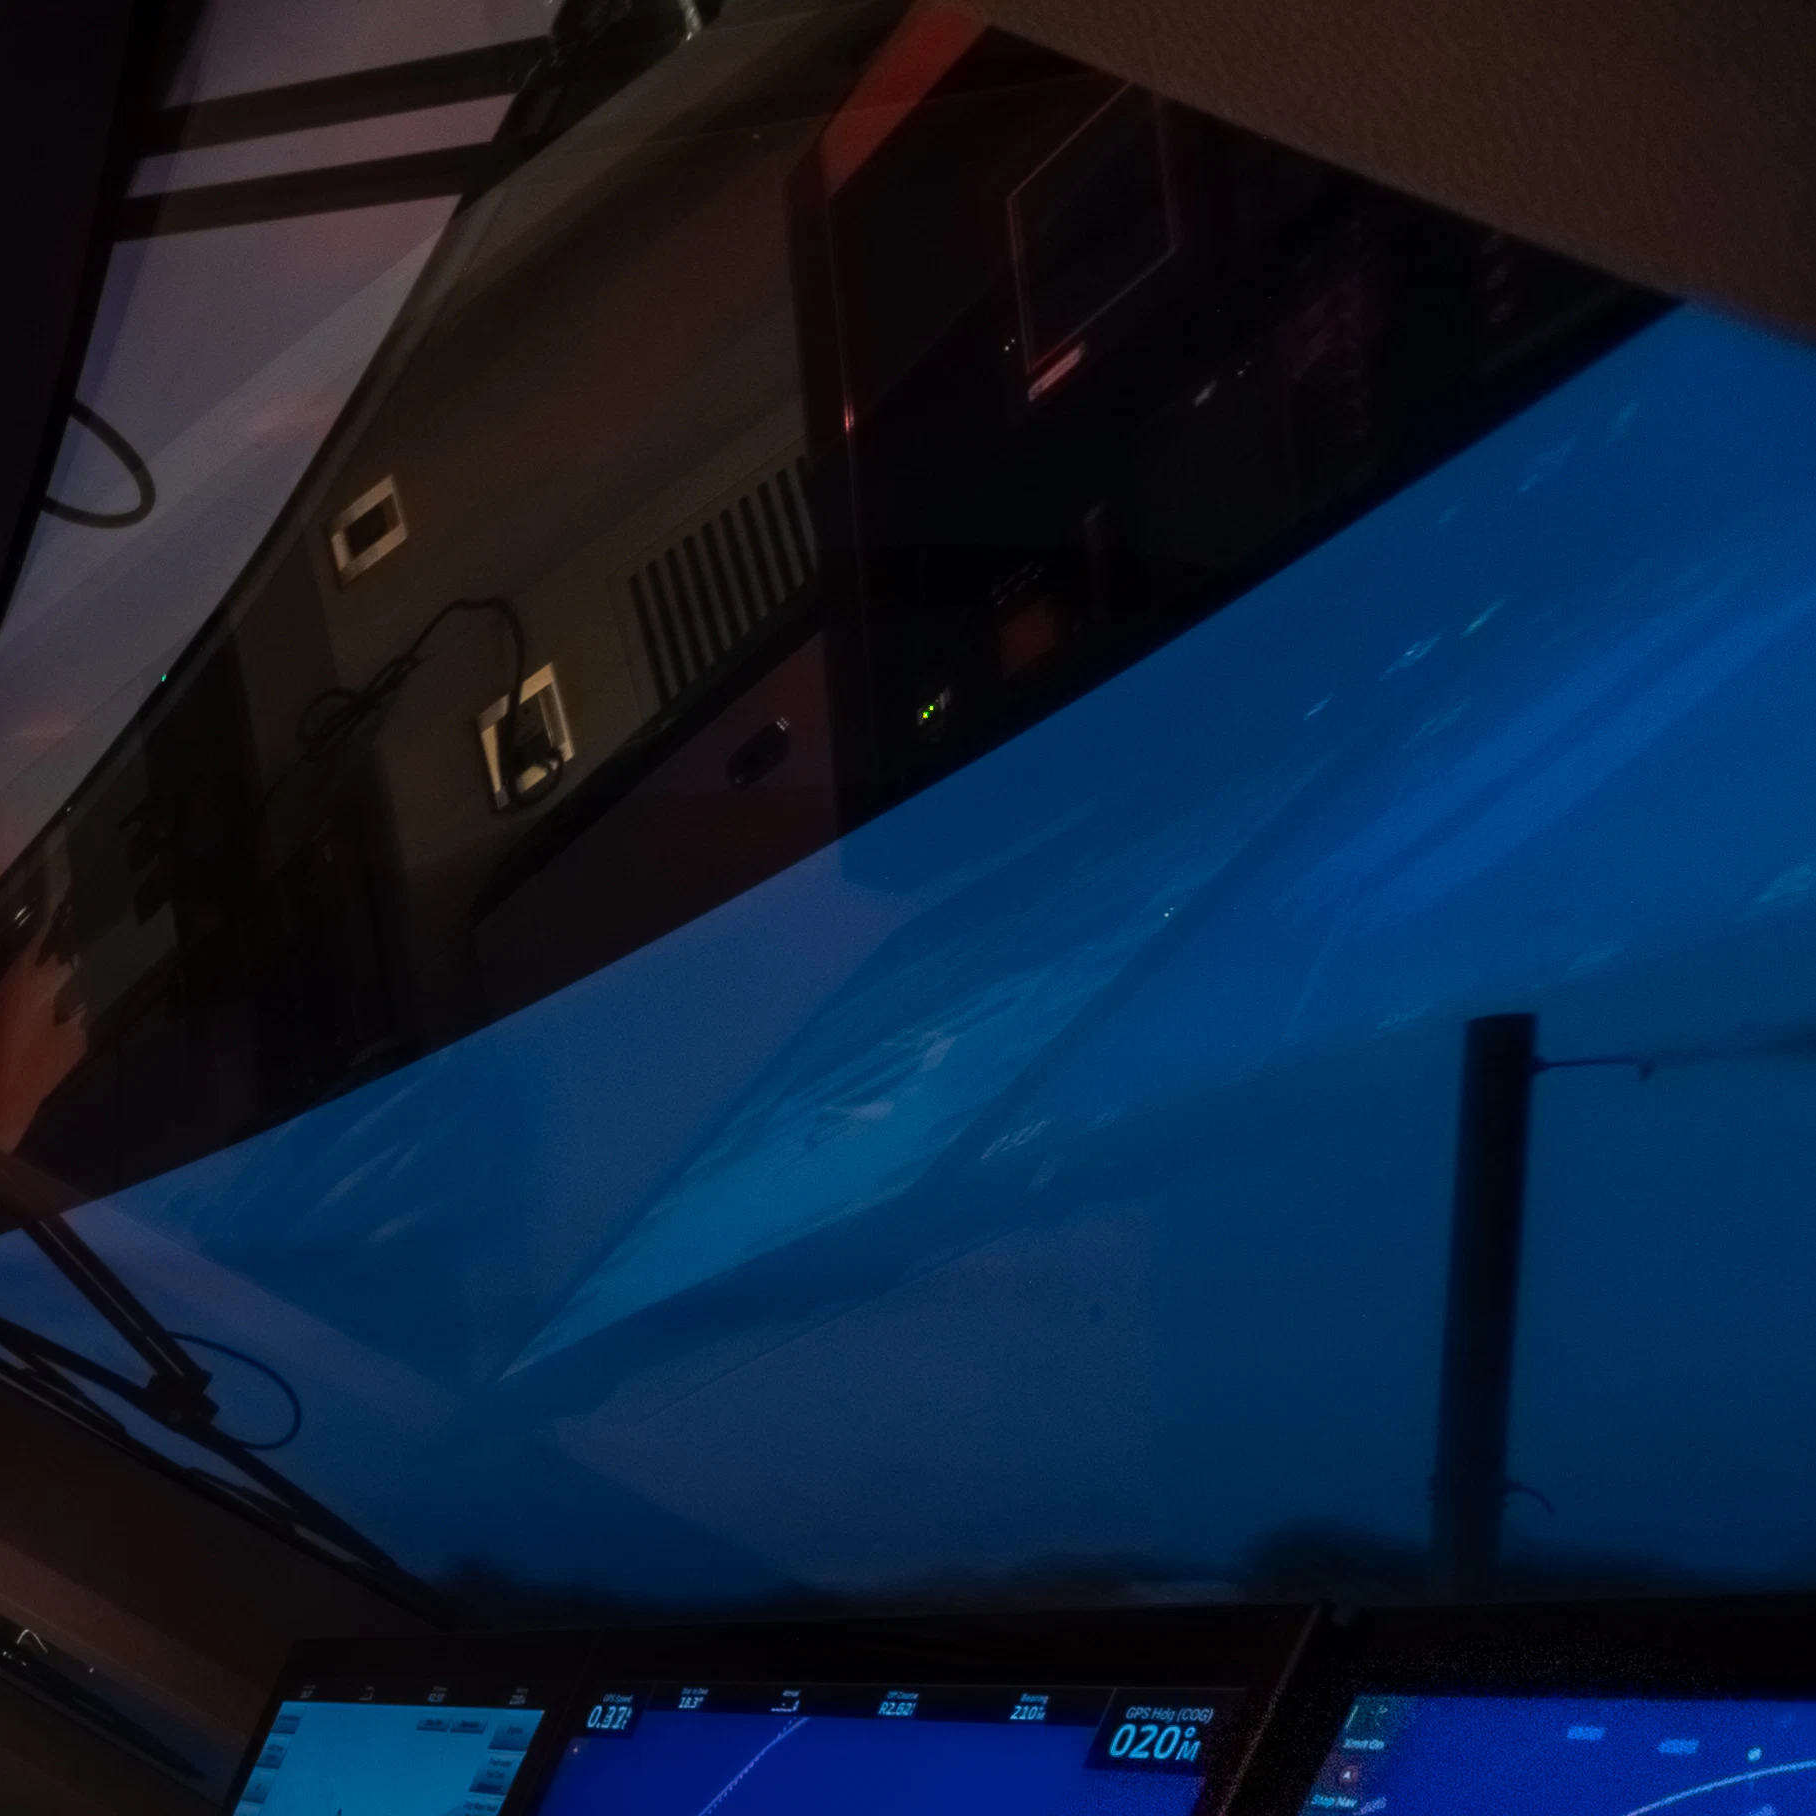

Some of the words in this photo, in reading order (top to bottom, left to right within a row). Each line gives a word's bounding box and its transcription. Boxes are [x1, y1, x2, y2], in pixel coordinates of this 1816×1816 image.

[1125, 1707, 1149, 1719] GPS
[1152, 1708, 1174, 1722] Hdg
[1176, 1708, 1214, 1724] (COG)
